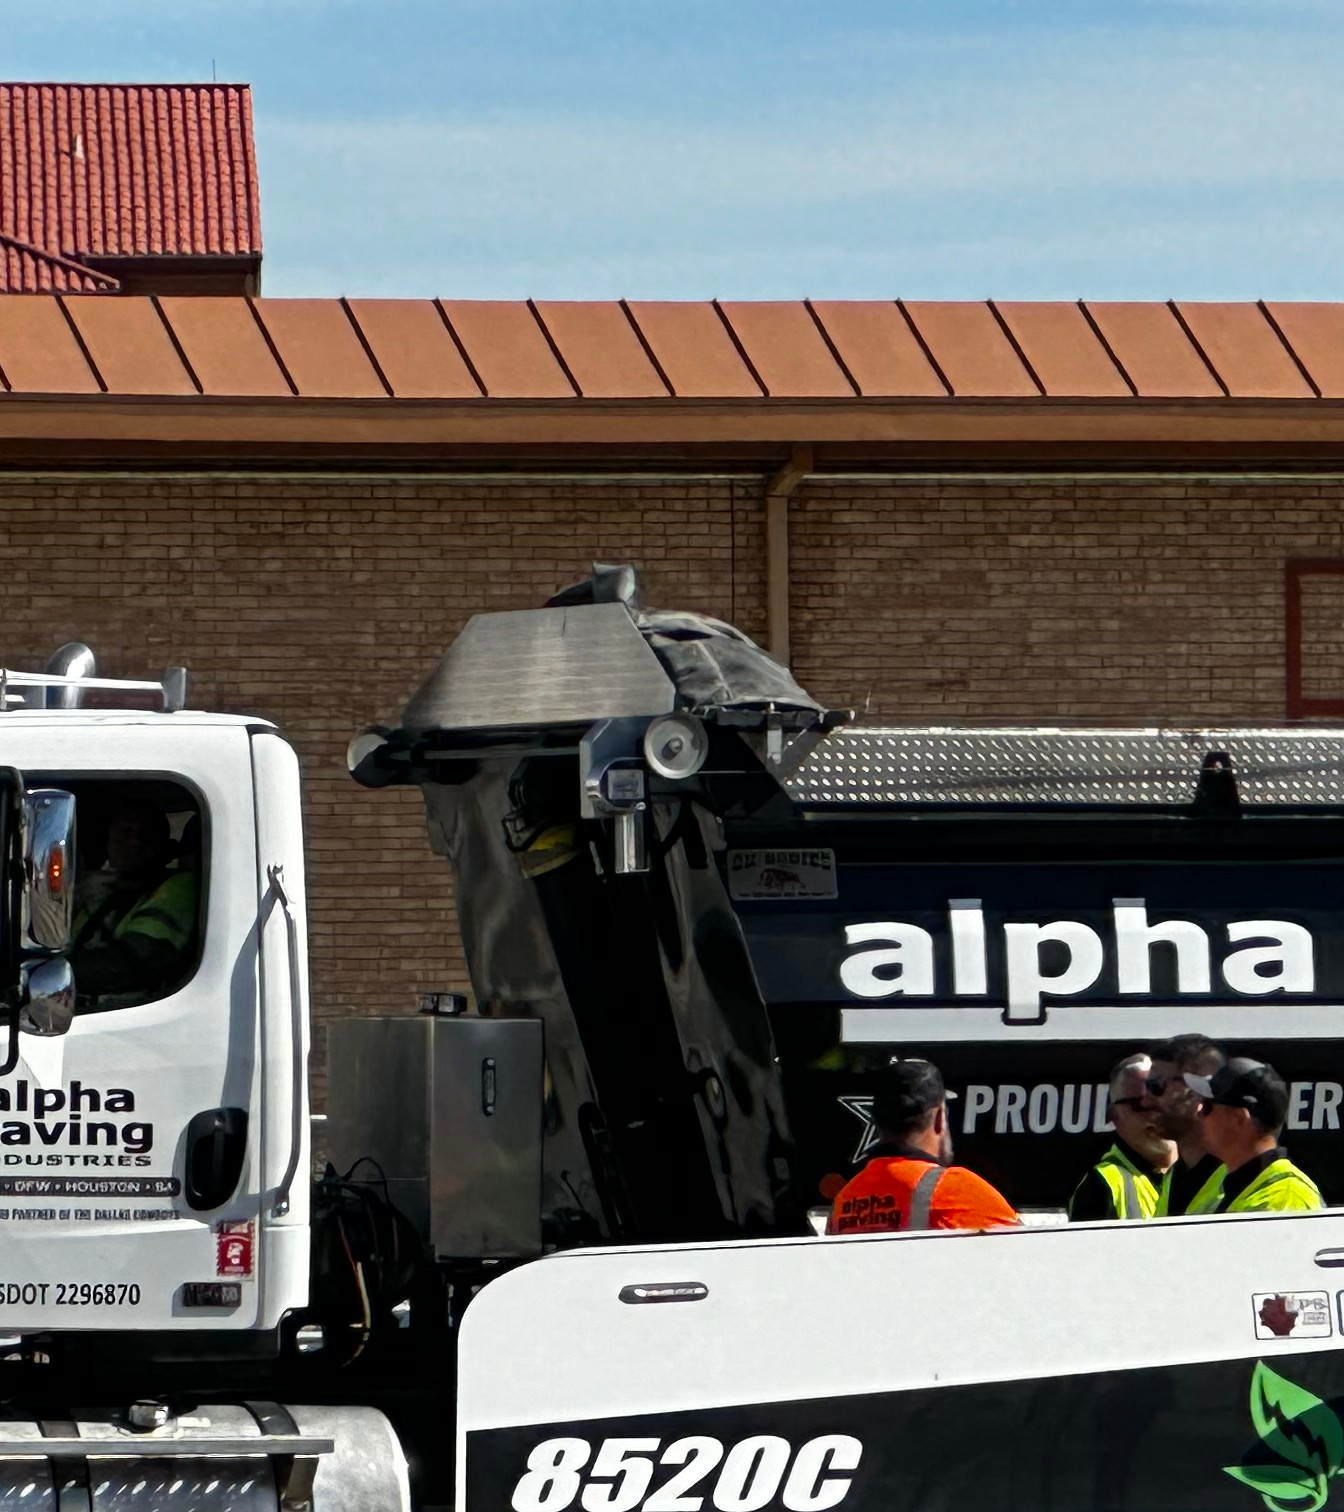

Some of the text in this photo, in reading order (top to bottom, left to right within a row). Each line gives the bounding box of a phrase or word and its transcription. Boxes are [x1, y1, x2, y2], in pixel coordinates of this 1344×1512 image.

[838, 897, 1315, 1025] alpha
[0, 1113, 154, 1154] aving
[3, 1154, 152, 1167] DUSTRIES
[65, 1180, 140, 1193] HOUSTON
[0, 1283, 141, 1306] SDOT 2296870
